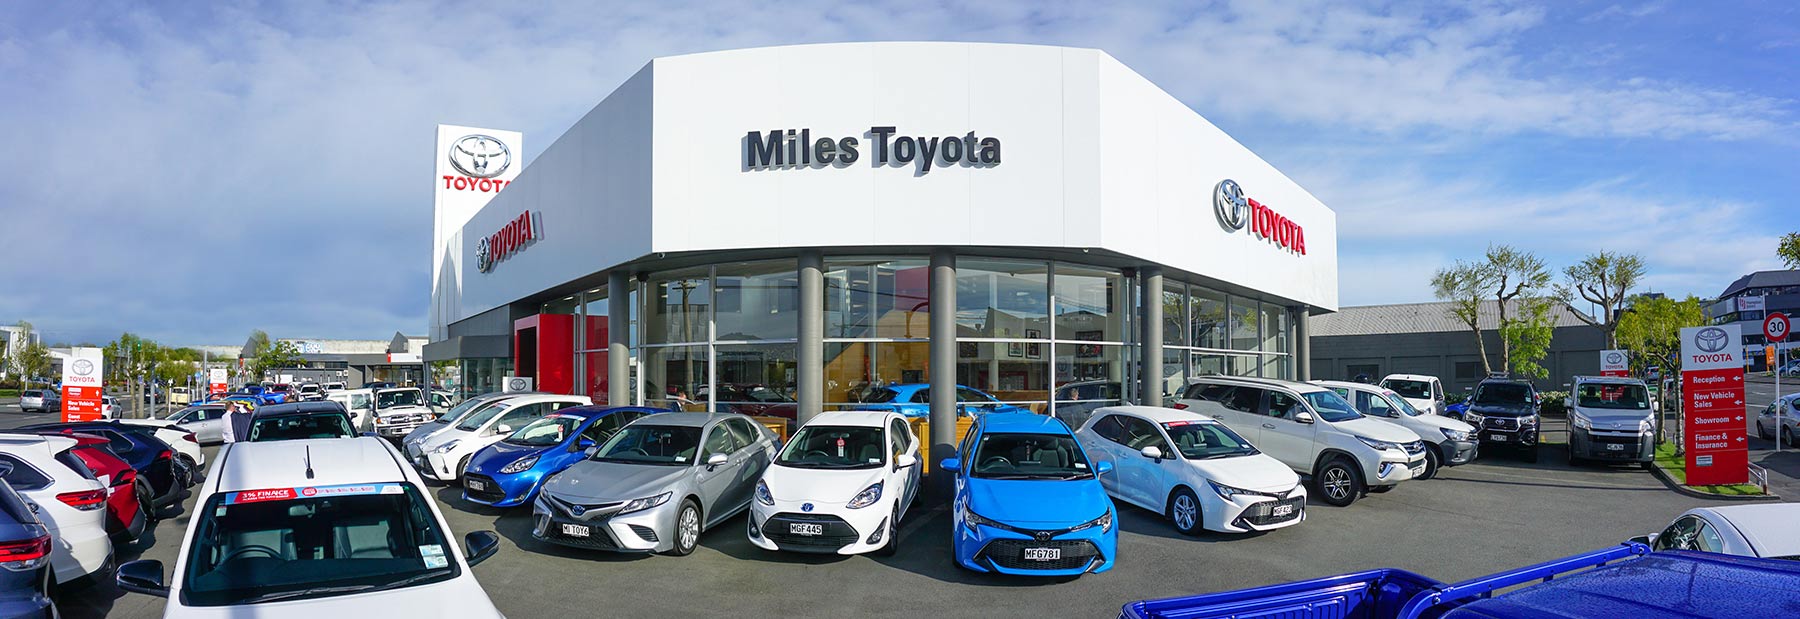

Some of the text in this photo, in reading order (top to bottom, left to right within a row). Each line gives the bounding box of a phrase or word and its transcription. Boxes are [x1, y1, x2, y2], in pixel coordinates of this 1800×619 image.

[747, 126, 1001, 173] Miles Toyota
[1247, 197, 1306, 256] TOYOTA
[488, 209, 532, 263] TOYOTA
[1769, 321, 1785, 333] 30
[1692, 353, 1733, 363] TOYOTA
[1693, 375, 1726, 385] Reception
[1693, 391, 1735, 401] New Vehicle
[1694, 401, 1713, 409] Sales
[1694, 416, 1730, 425] Showroom
[1695, 432, 1728, 441] Finance &
[1695, 441, 1728, 449] Insurance
[791, 524, 823, 534] MGF445
[1025, 549, 1059, 559] MFG781
